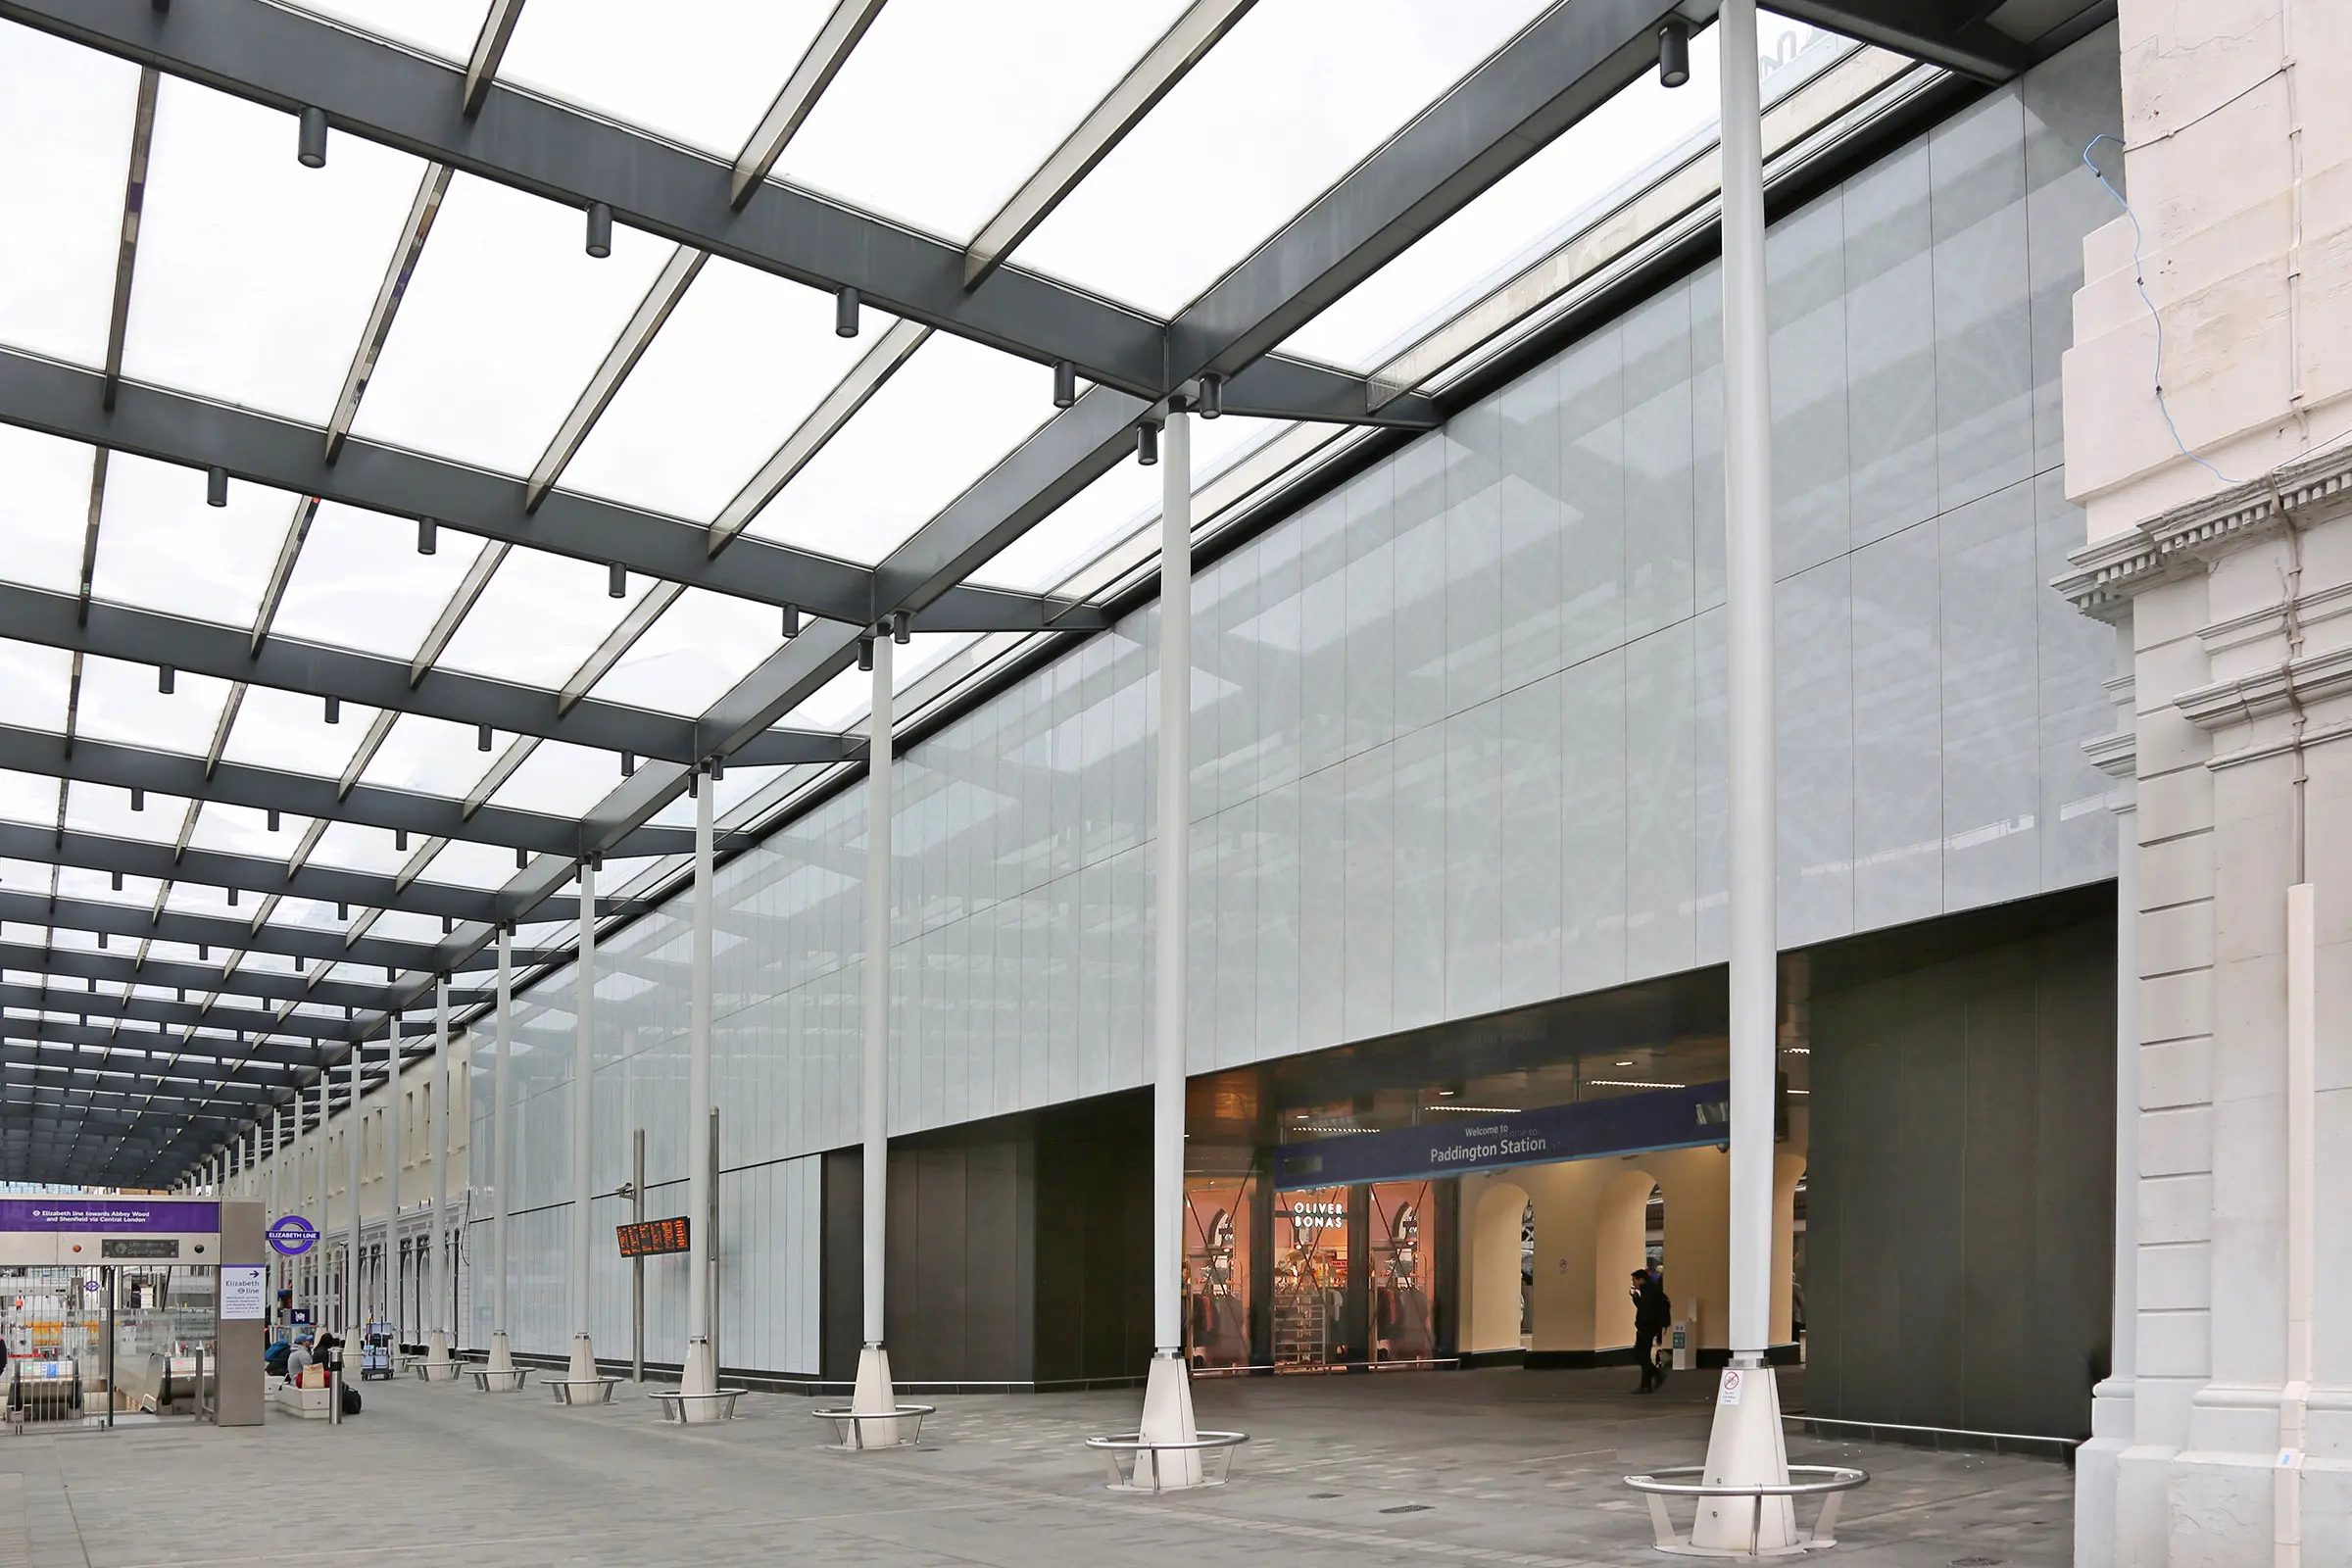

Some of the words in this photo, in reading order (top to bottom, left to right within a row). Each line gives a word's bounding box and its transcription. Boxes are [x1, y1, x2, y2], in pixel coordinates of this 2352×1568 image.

[1465, 1125, 1498, 1137] Welcome
[1499, 1124, 1508, 1133] to
[1431, 1144, 1497, 1162] Paddington
[1500, 1137, 1546, 1154] Station
[1294, 1201, 1343, 1215] OLIVER
[1295, 1215, 1343, 1228] BONAS
